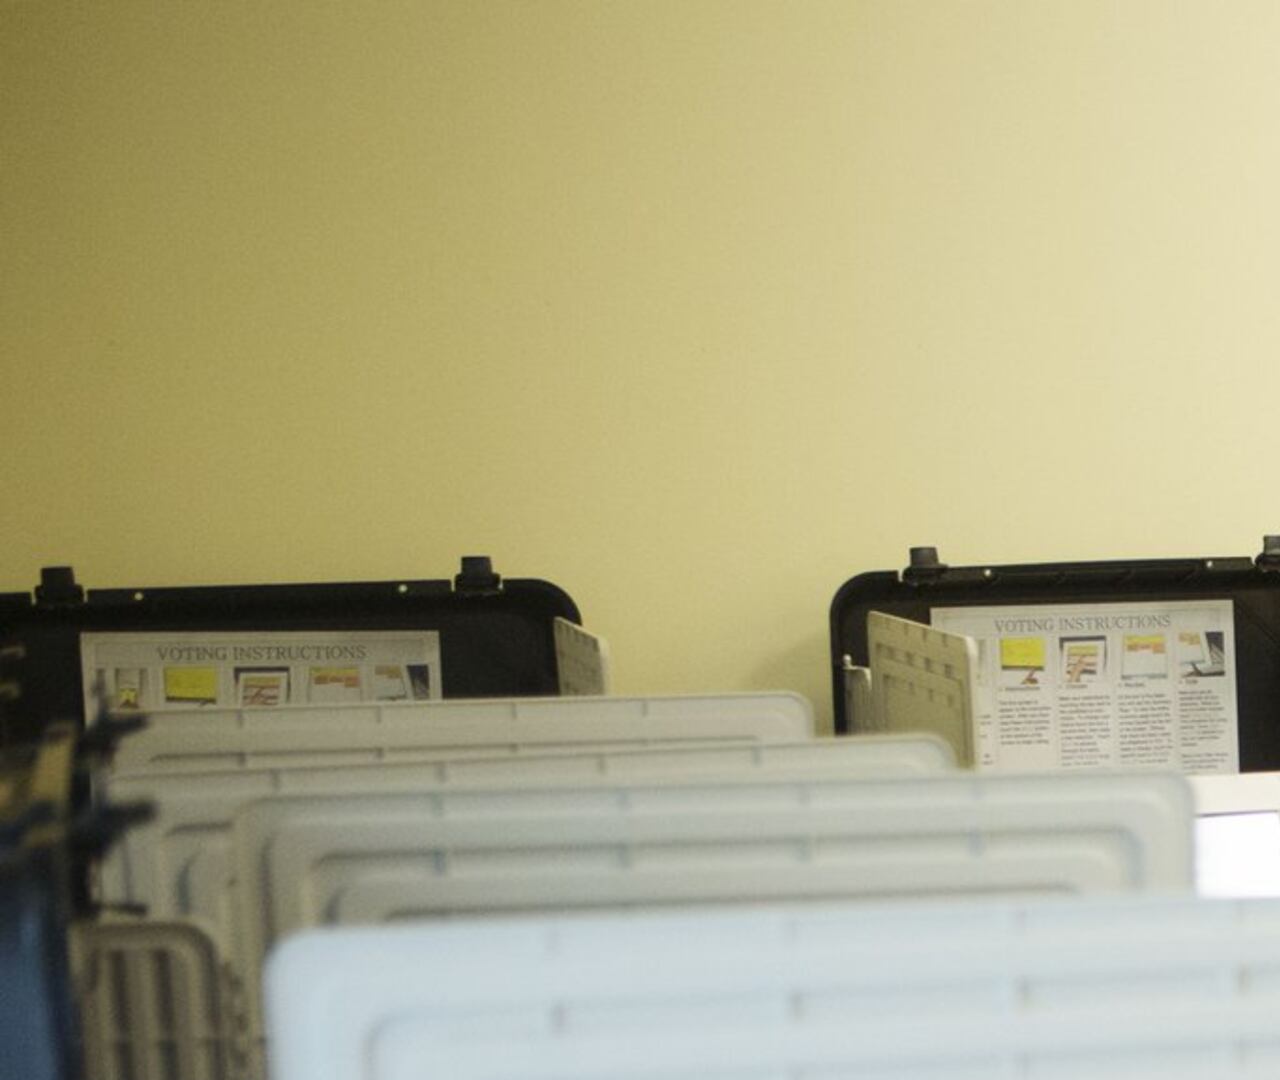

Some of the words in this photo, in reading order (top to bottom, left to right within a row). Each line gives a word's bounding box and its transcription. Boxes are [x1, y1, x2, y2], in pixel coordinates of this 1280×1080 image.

[994, 617, 1054, 634] VOTING
[1058, 613, 1172, 632] INSTRUCTIONS
[157, 645, 229, 662] VOTING
[234, 644, 369, 662] INSTRUCTIONS
